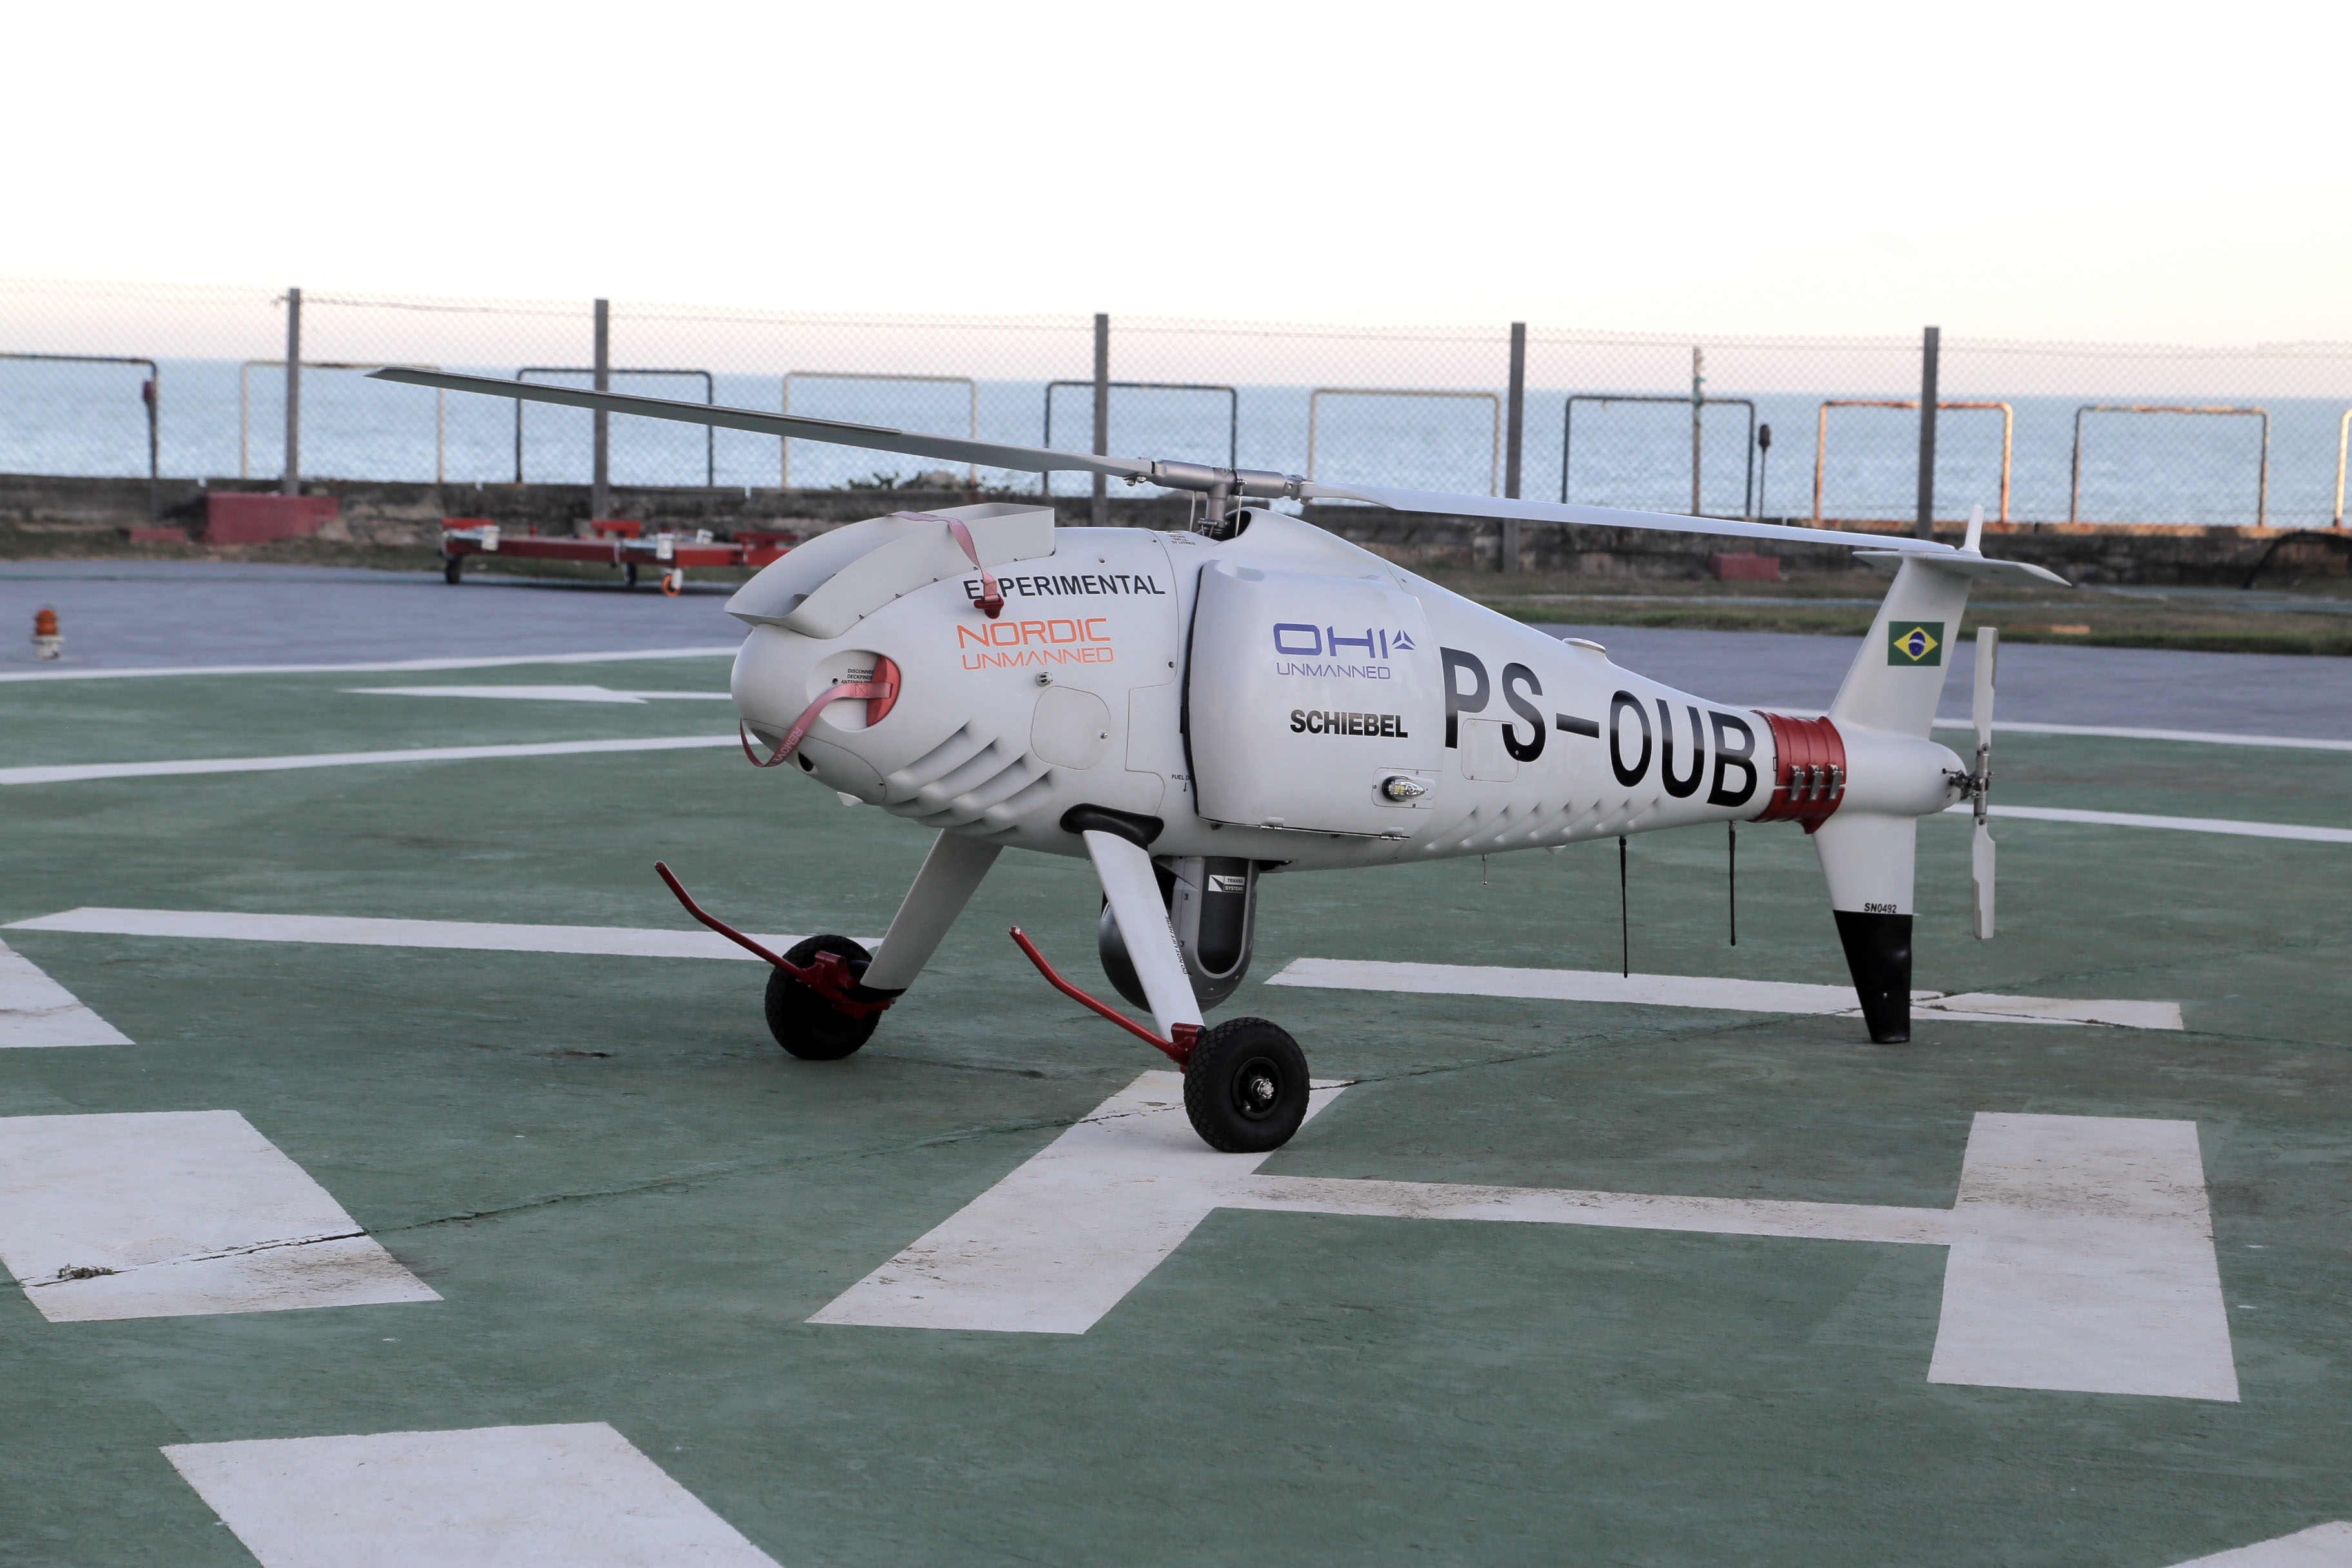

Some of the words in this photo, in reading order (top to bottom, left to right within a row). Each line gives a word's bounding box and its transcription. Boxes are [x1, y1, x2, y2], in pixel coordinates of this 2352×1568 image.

[963, 575, 1165, 600] EPERIMENTAL
[957, 618, 1111, 649] NORDIC
[1273, 623, 1388, 659] OHI
[963, 647, 1113, 670] UNMANNED
[1277, 662, 1391, 680] UNMANNED
[1290, 709, 1408, 738] SCHIEBEL
[1440, 647, 1757, 807] PS-OUB
[1864, 903, 1897, 914] SN0492
[1181, 965, 1187, 975] DO
